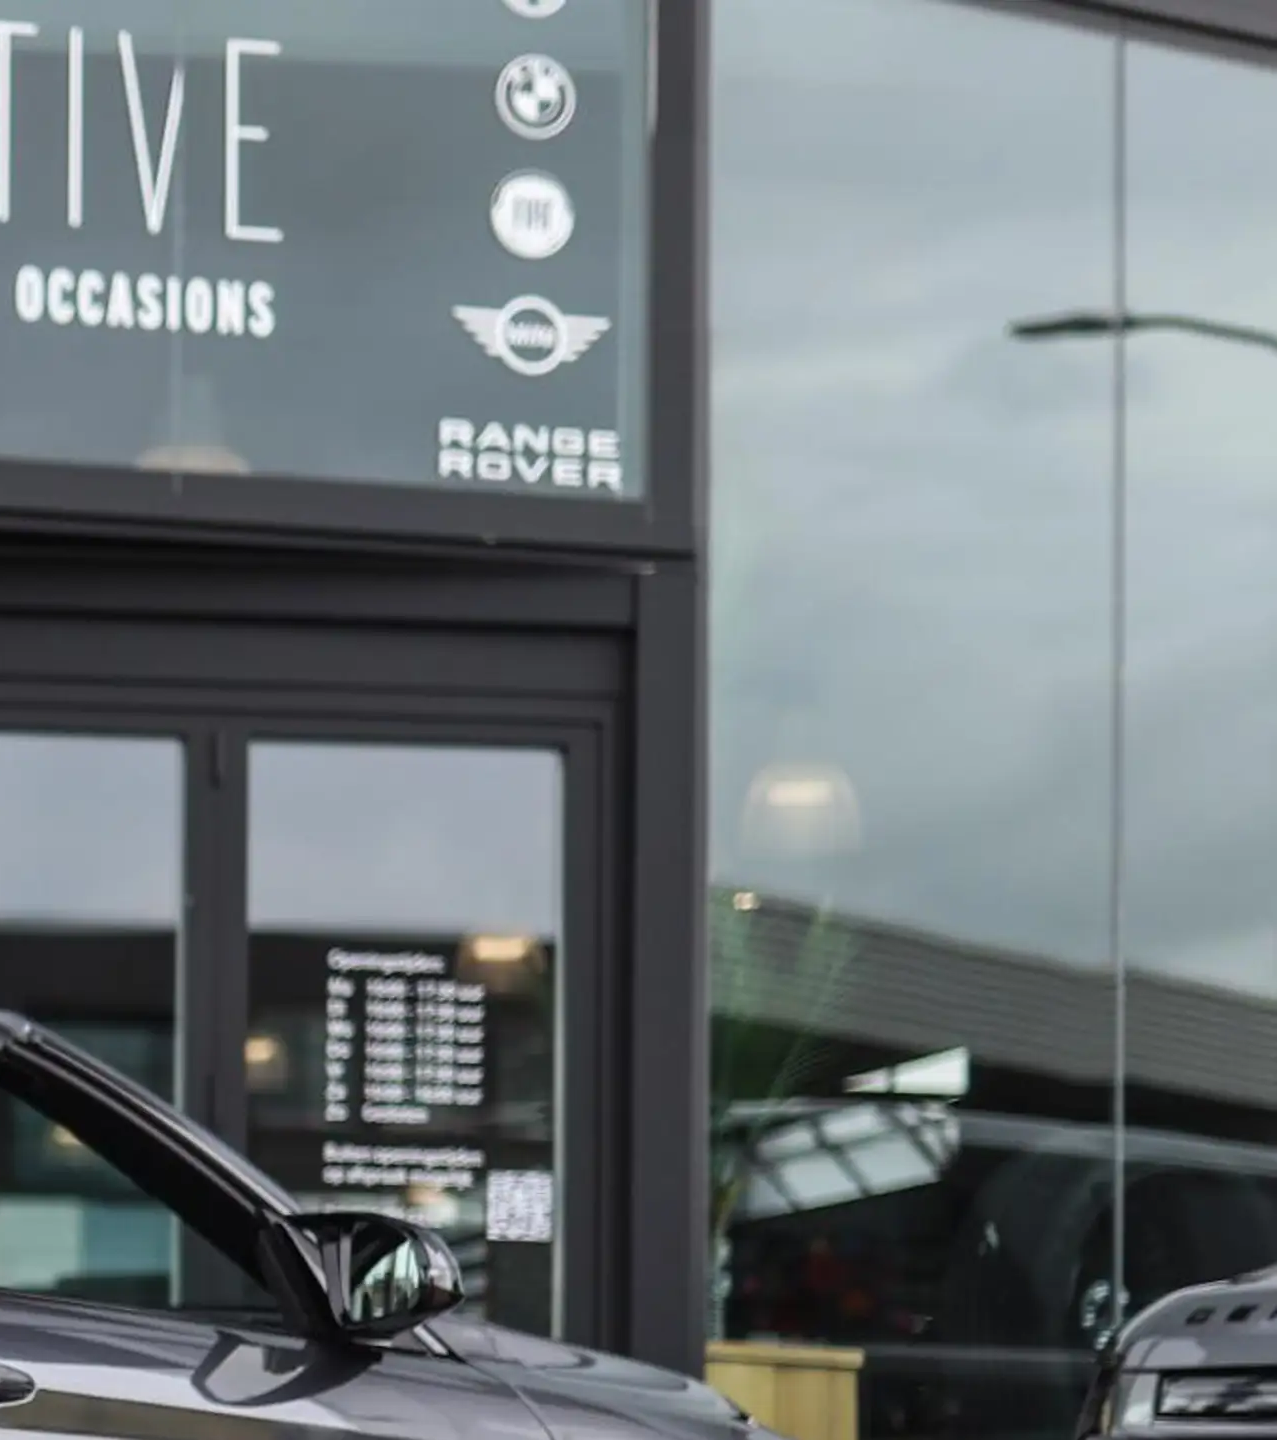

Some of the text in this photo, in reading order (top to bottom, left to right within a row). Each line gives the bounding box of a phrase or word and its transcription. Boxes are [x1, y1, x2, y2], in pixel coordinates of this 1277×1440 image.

[15, 264, 276, 338] OCCASIONS
[438, 417, 620, 458] RANGE
[438, 449, 623, 492] ROVER
